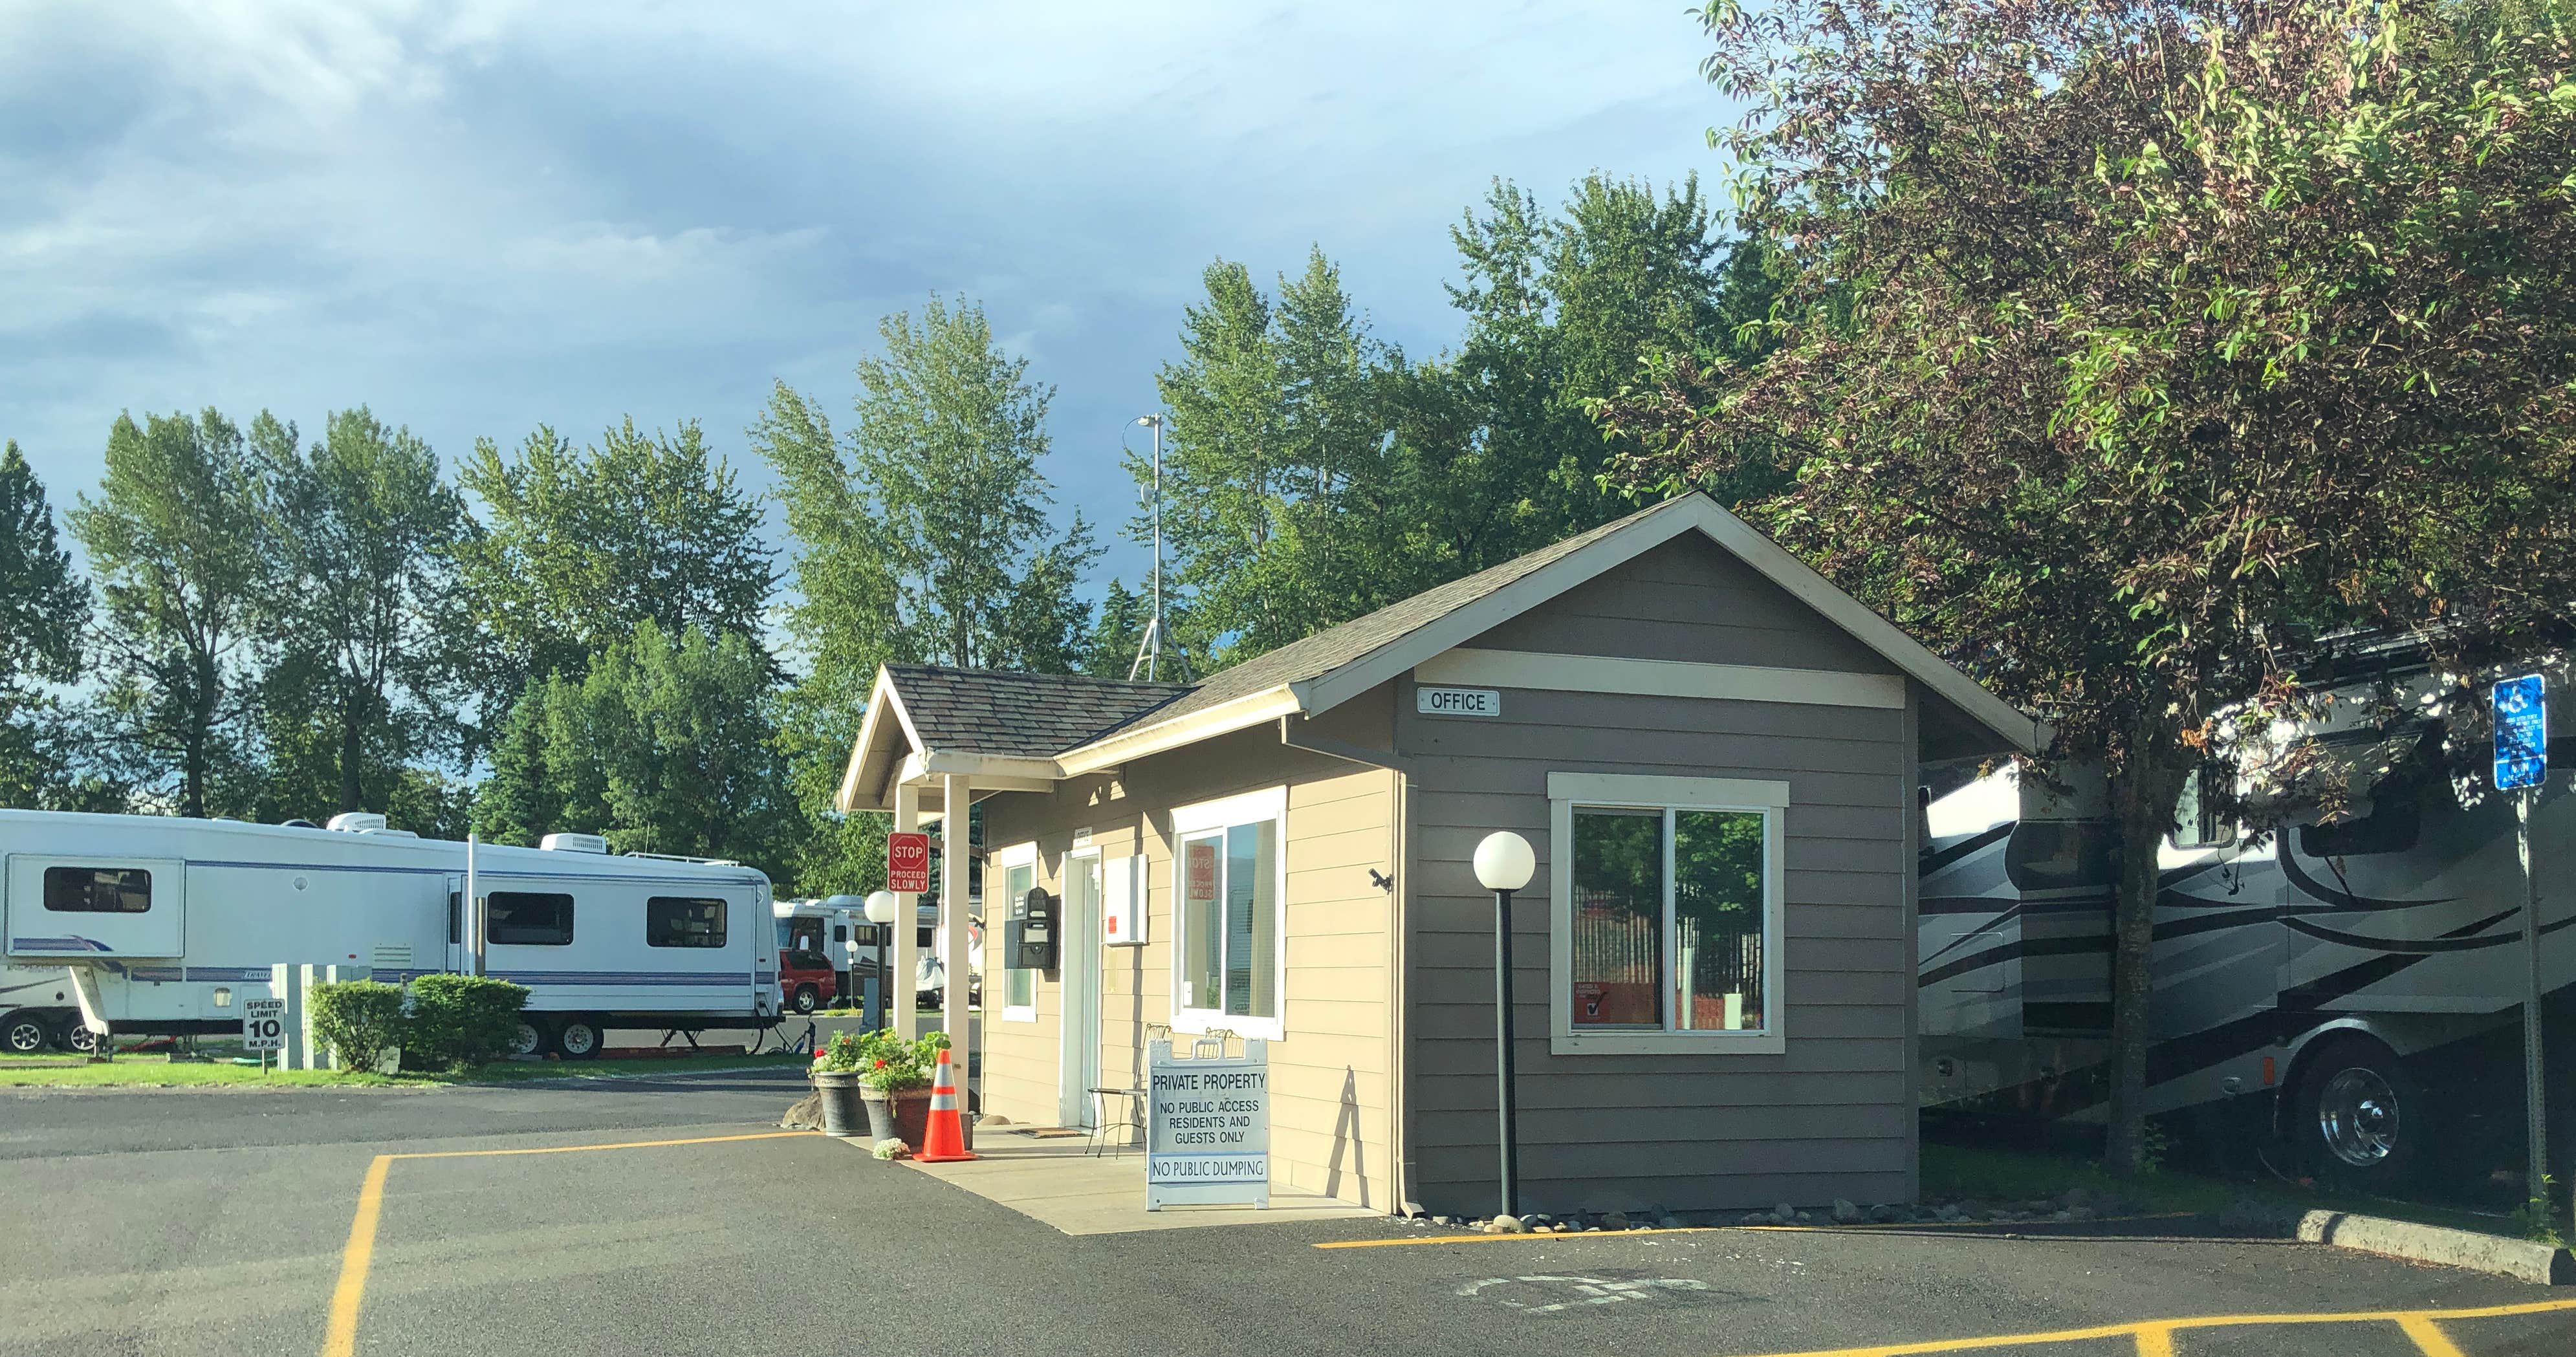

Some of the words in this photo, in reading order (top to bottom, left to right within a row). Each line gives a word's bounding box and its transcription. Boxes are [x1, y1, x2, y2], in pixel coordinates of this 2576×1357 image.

[1431, 692, 1485, 710] OFFICE
[895, 846, 922, 858] STOP
[891, 870, 926, 878] PROCEED
[891, 879, 925, 890] SLOWLY
[246, 1001, 283, 1010] SPEED
[249, 1019, 281, 1038] 10
[248, 1039, 281, 1048] M.P.H.
[1153, 1075, 1199, 1091] PRIVATE
[1203, 1073, 1265, 1089] PROPERTY
[1160, 1102, 1175, 1114] NO
[1179, 1102, 1214, 1113] PUBLIC
[1218, 1100, 1259, 1112] ACCESS
[1170, 1116, 1225, 1129] RESIDENTS
[1229, 1116, 1250, 1127] AND
[1175, 1132, 1216, 1144] GUESTS
[1219, 1131, 1245, 1143] ONLY
[1153, 1162, 1170, 1176] NO
[1173, 1161, 1210, 1176] PUBLIC
[1213, 1160, 1263, 1176] DUMPING
